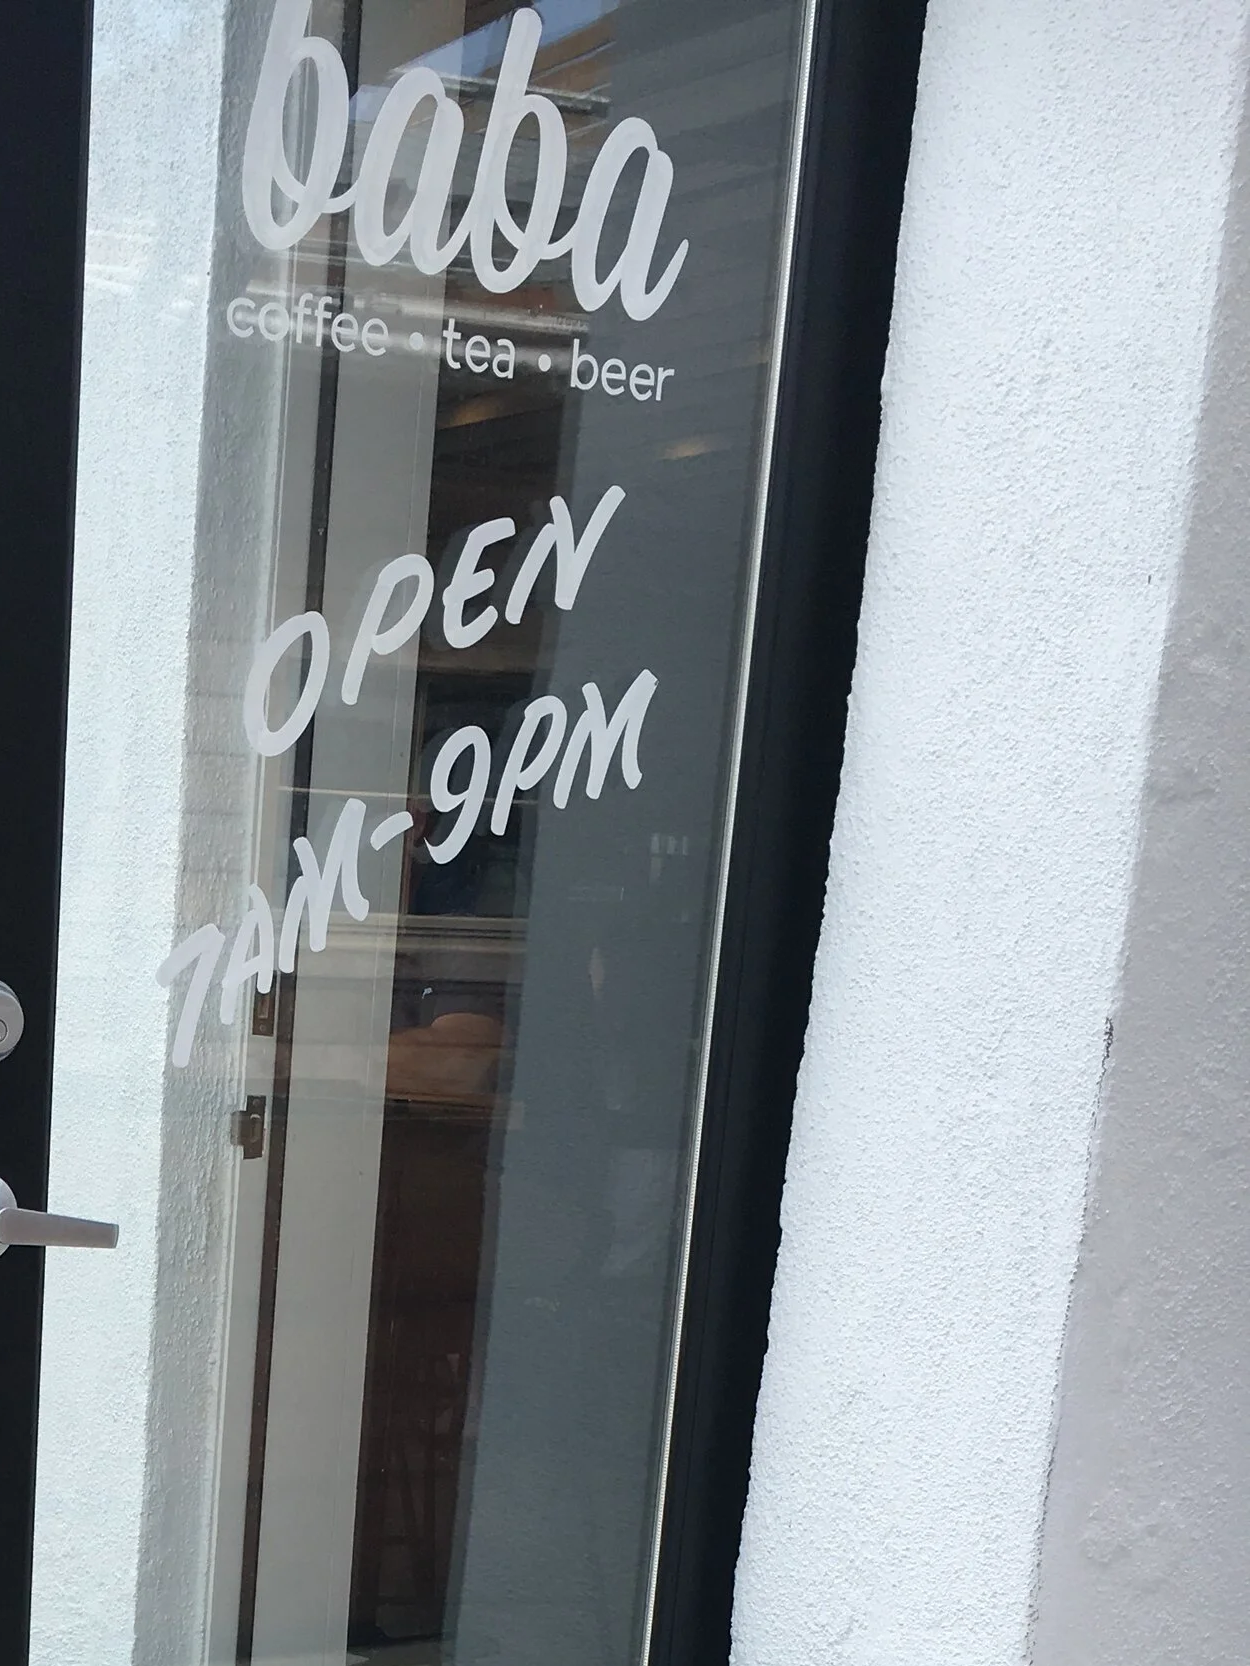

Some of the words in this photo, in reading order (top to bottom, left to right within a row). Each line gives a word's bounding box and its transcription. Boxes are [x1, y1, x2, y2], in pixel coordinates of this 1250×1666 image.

[242, 0, 689, 321] baba
[226, 292, 389, 356] coffee
[442, 318, 516, 379] tea
[570, 338, 675, 402] beer
[243, 484, 627, 757] OPEN
